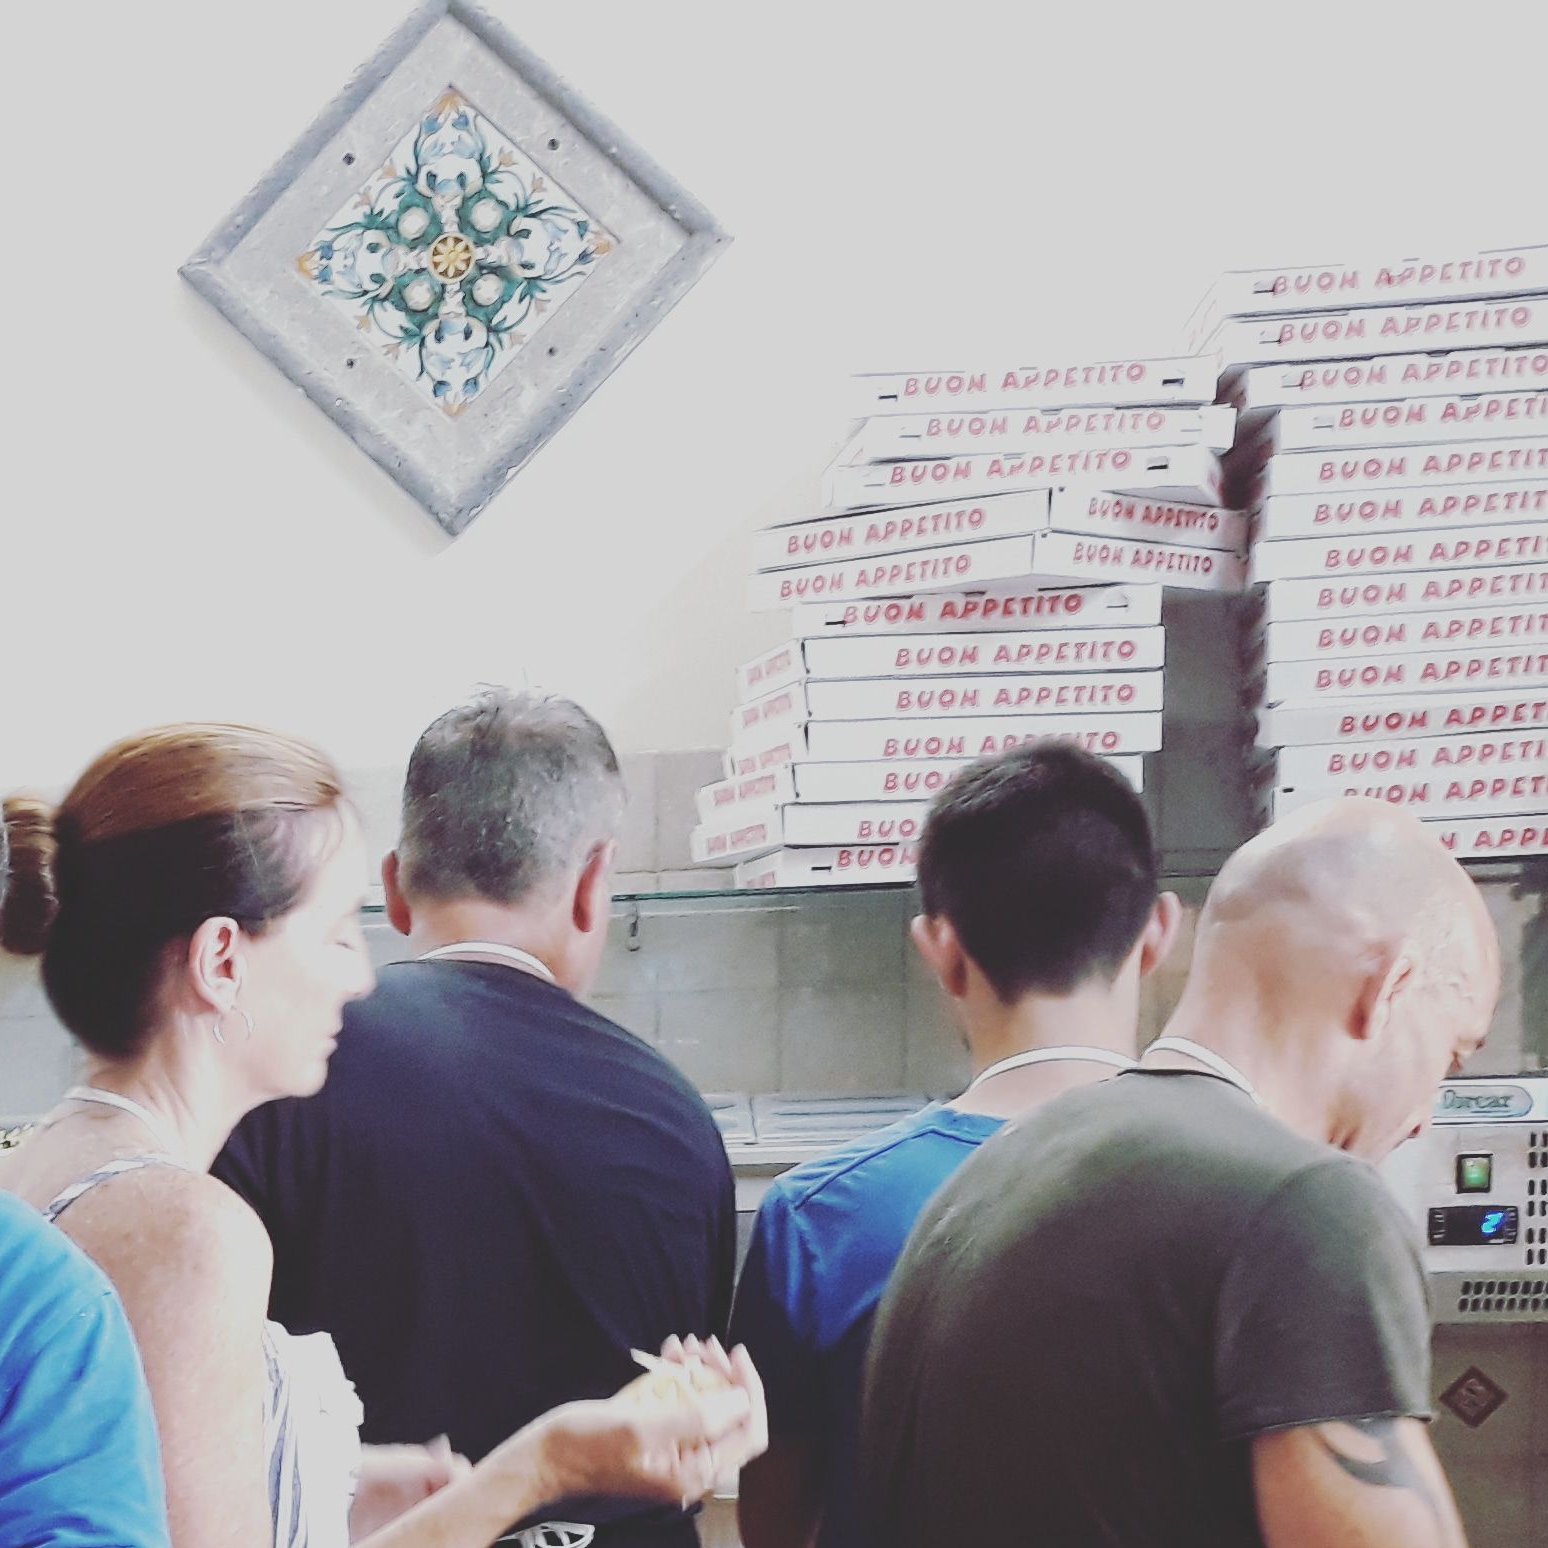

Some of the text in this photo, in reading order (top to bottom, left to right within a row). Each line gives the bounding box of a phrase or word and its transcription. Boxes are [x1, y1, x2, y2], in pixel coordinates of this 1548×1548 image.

[1272, 257, 1525, 296] BUON APPETITO
[1279, 306, 1531, 343] BUON APPETITO
[903, 362, 1146, 397] BUON APPETITO
[1301, 364, 1387, 390] BUON
[926, 411, 1166, 437] BUON APPETITO
[1339, 397, 1548, 428] BUON APPETI
[889, 450, 1132, 485] BUON APPETITO
[1319, 448, 1548, 482] BUON APPETIT
[1314, 490, 1548, 524] BUON APPETIT
[788, 508, 984, 554] BUON APPETITO
[1073, 542, 1122, 563] BUON
[1325, 535, 1548, 569] BUON APPETI
[780, 554, 972, 598] BUON APPETITO
[1317, 573, 1548, 608] BUON APPETIT
[843, 593, 1084, 625] BUON APPETITO
[1317, 613, 1548, 648] BUON APPETIT
[895, 639, 1137, 668] BUON APPETITO
[1316, 654, 1548, 690] BUON APPETIT
[895, 683, 1137, 711] BUON APPETITO
[1338, 702, 1548, 735] BUON APPET
[883, 736, 965, 757] BUON
[1328, 740, 1548, 775] BUON APPETI
[883, 771, 943, 792] BUO
[1446, 775, 1548, 800] APPET
[858, 819, 917, 839] BUO
